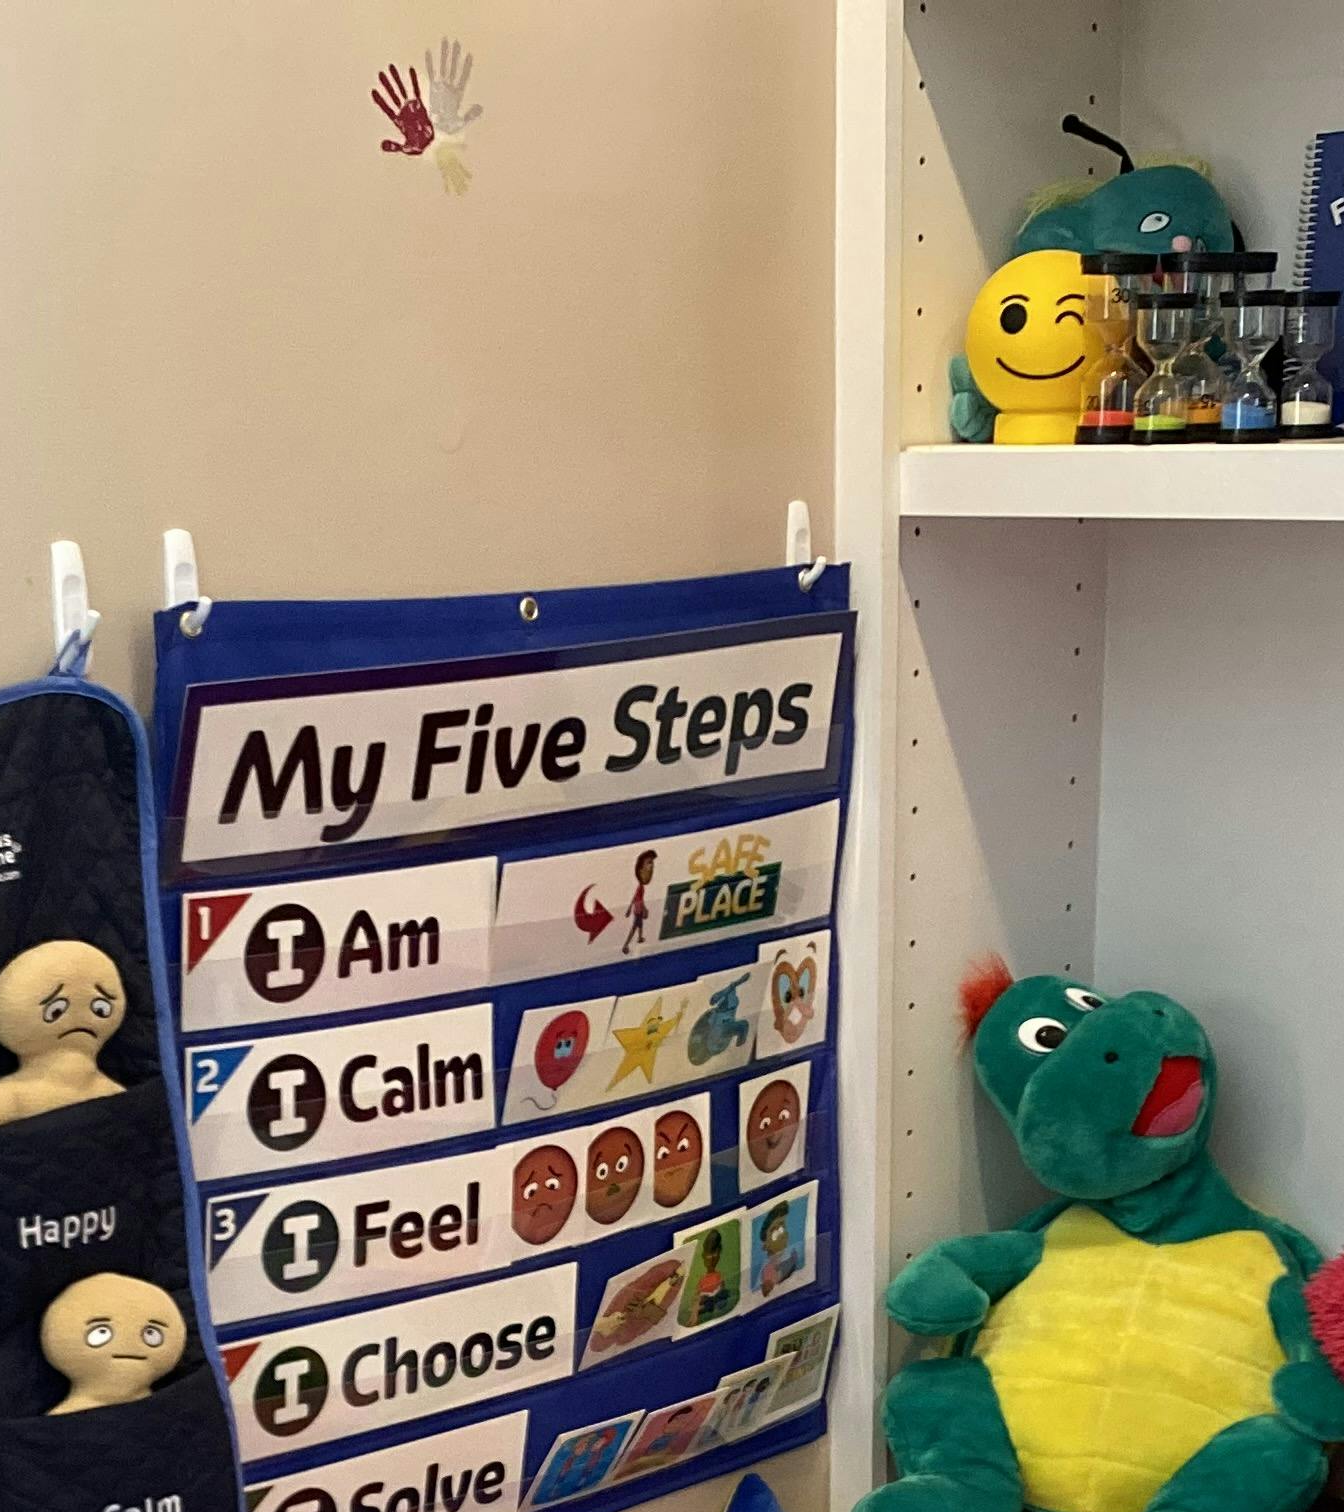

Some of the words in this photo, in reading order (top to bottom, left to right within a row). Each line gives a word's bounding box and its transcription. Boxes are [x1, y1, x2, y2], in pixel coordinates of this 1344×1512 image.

[218, 725, 386, 844] My
[410, 702, 588, 802] Five
[604, 681, 814, 777] Steps
[675, 875, 769, 929] PLACE
[687, 833, 772, 891] SAFE
[197, 905, 213, 941] 1
[264, 917, 307, 990] I
[337, 909, 441, 980] Am
[195, 1059, 220, 1094] 2
[267, 1069, 310, 1138] I
[339, 1043, 484, 1123] Calm
[19, 1204, 117, 1250] Happy
[213, 1209, 236, 1241] 3
[282, 1213, 324, 1282] I
[352, 1182, 481, 1269] Feel
[273, 1358, 312, 1426] I
[341, 1314, 557, 1408] Choose
